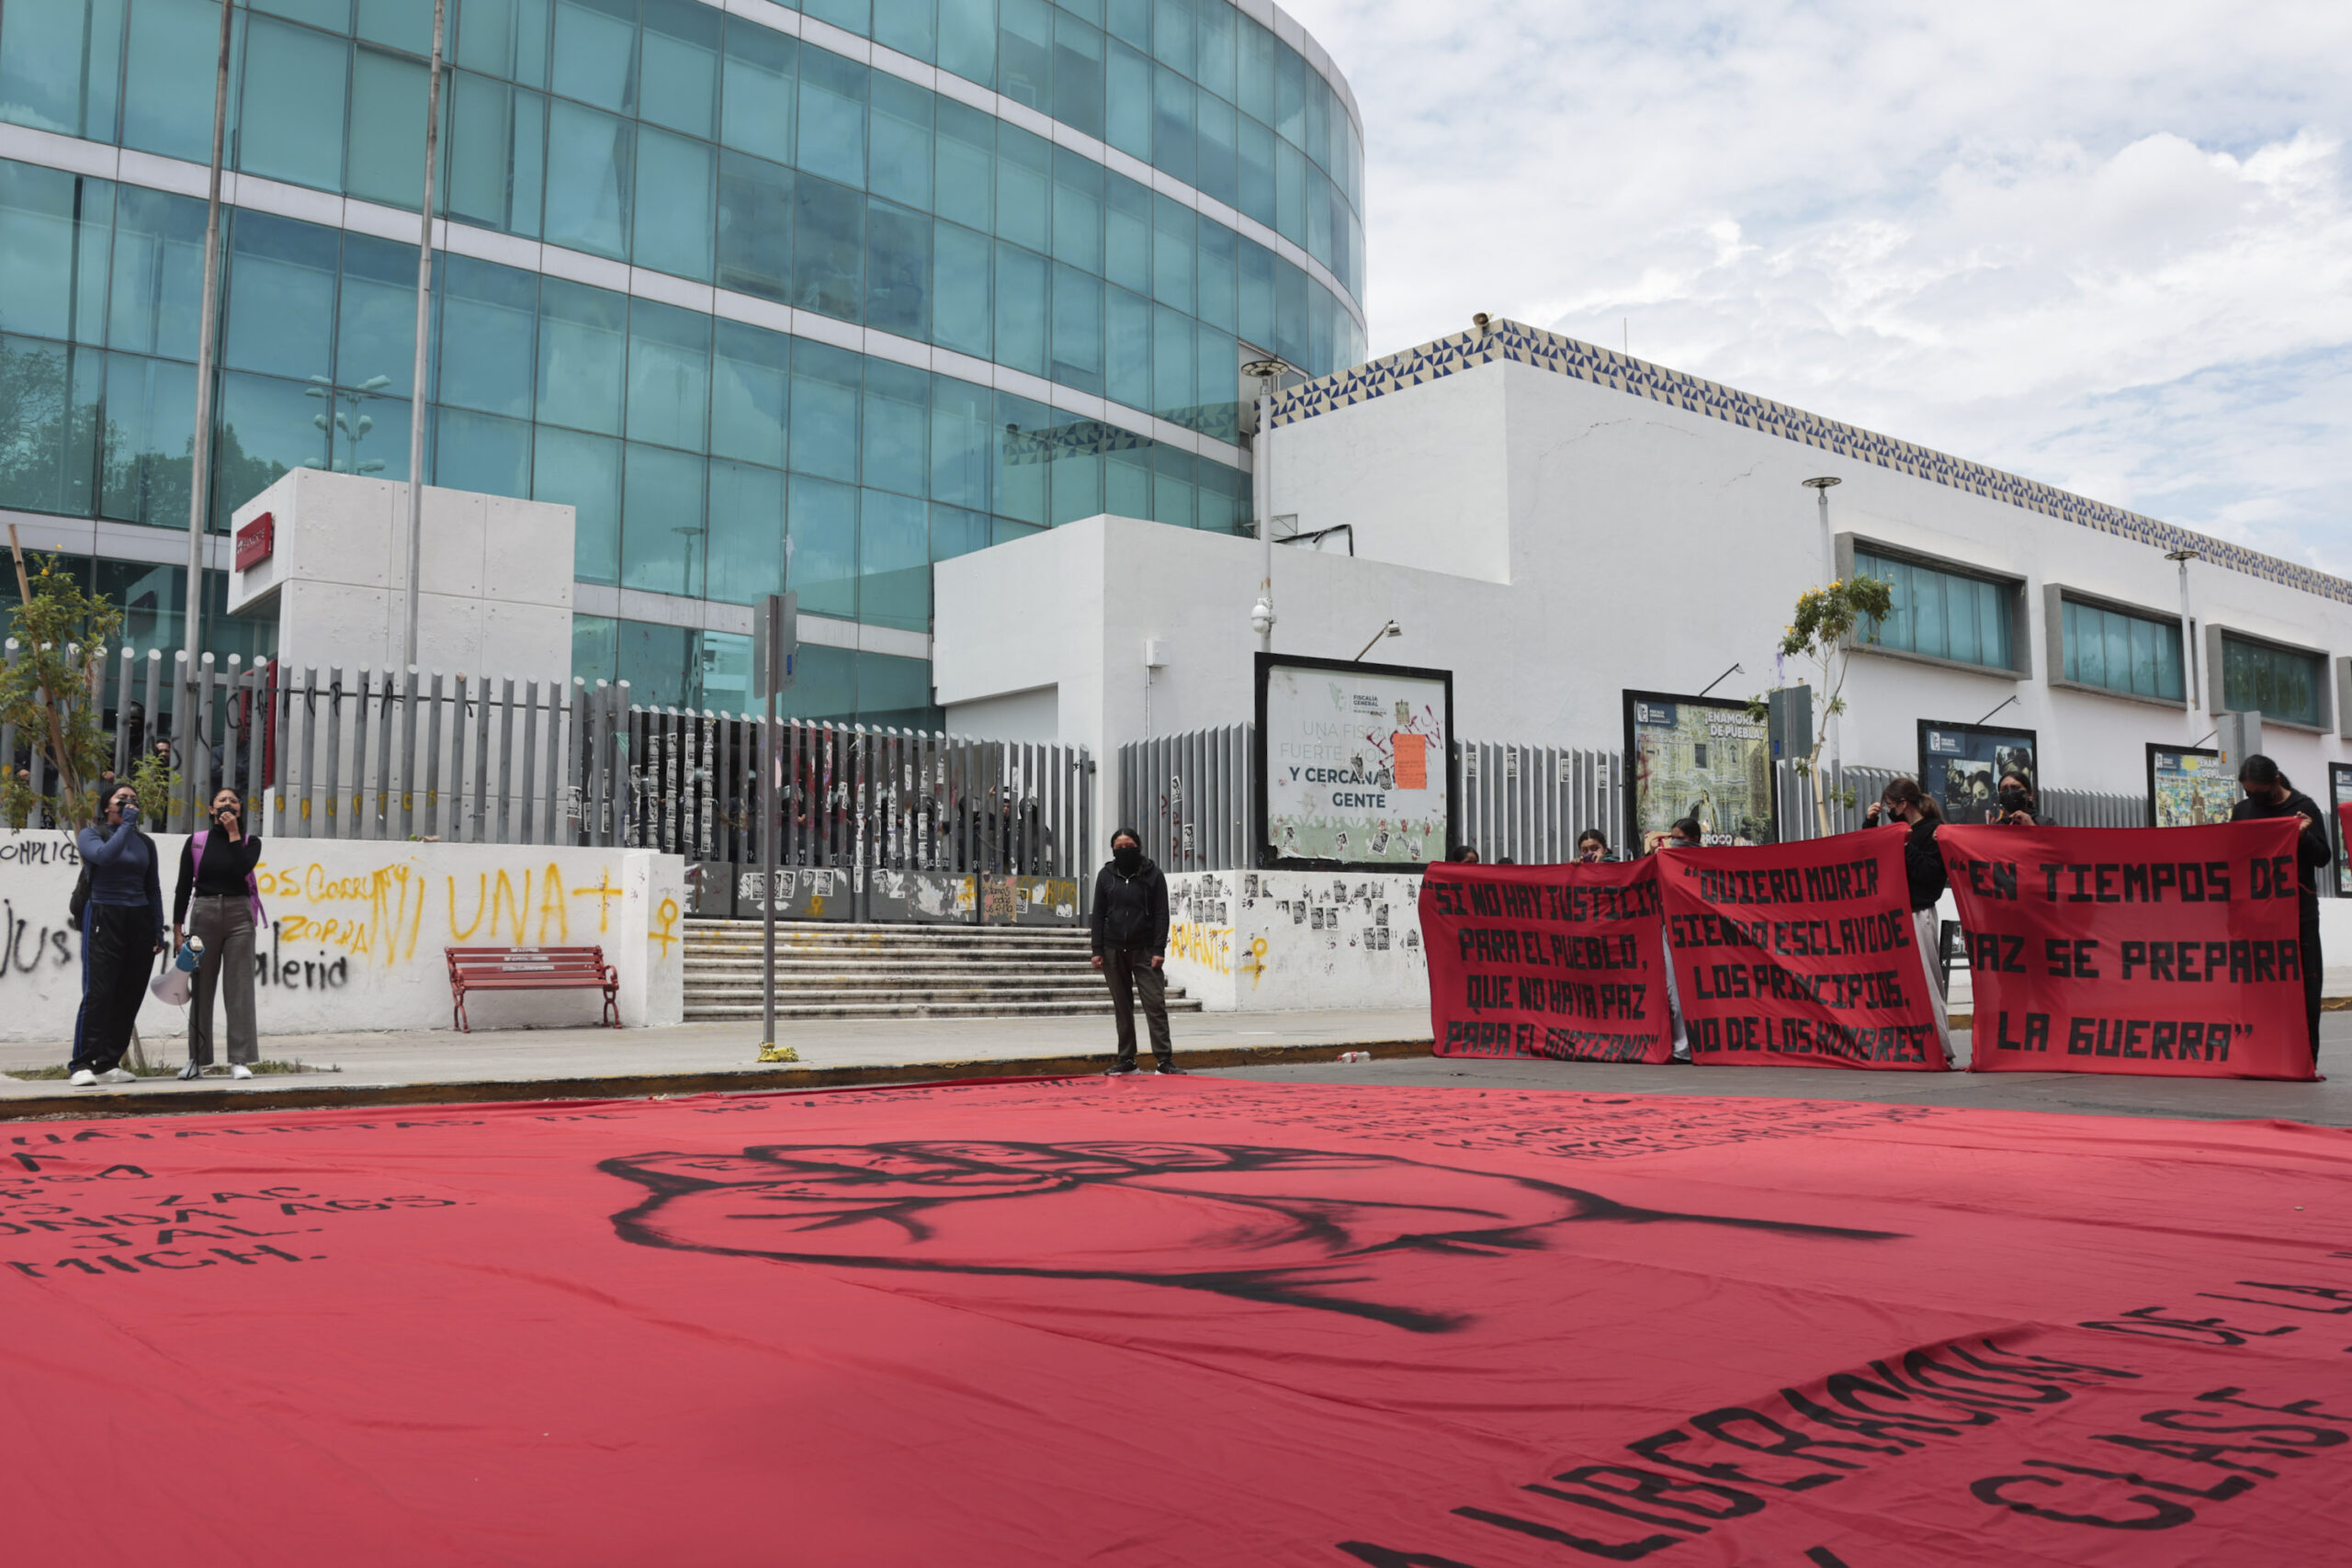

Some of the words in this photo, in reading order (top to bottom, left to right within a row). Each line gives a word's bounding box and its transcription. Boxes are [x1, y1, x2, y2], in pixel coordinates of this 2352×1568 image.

[1710, 724, 1724, 737] DE
[1289, 767, 1300, 782] Y
[1332, 792, 1385, 808] GENTE
[1804, 858, 1879, 903] MORIR
[2040, 862, 2231, 902] TIEMPOS
[2250, 854, 2296, 900] DE
[1469, 884, 1502, 917] NO
[1502, 883, 1543, 919] HAY
[1458, 928, 1520, 964] PARA
[1521, 931, 1550, 965] EL
[2044, 939, 2099, 978] SE
[2120, 939, 2300, 983] PREPARA
[1466, 975, 1514, 1015] QUE
[1518, 976, 1544, 1011] NO
[1548, 978, 1598, 1020] HAYA
[1600, 983, 1646, 1020] PAZ
[1693, 964, 1749, 999] LOS
[1443, 1021, 1511, 1055] PARA
[1515, 1023, 1540, 1057] EL
[1685, 1017, 1721, 1054] NO
[1725, 1016, 1760, 1051] DE
[1766, 1017, 1815, 1055] LOS
[1997, 1010, 2050, 1052] LA
[2076, 1305, 2301, 1347] DE
